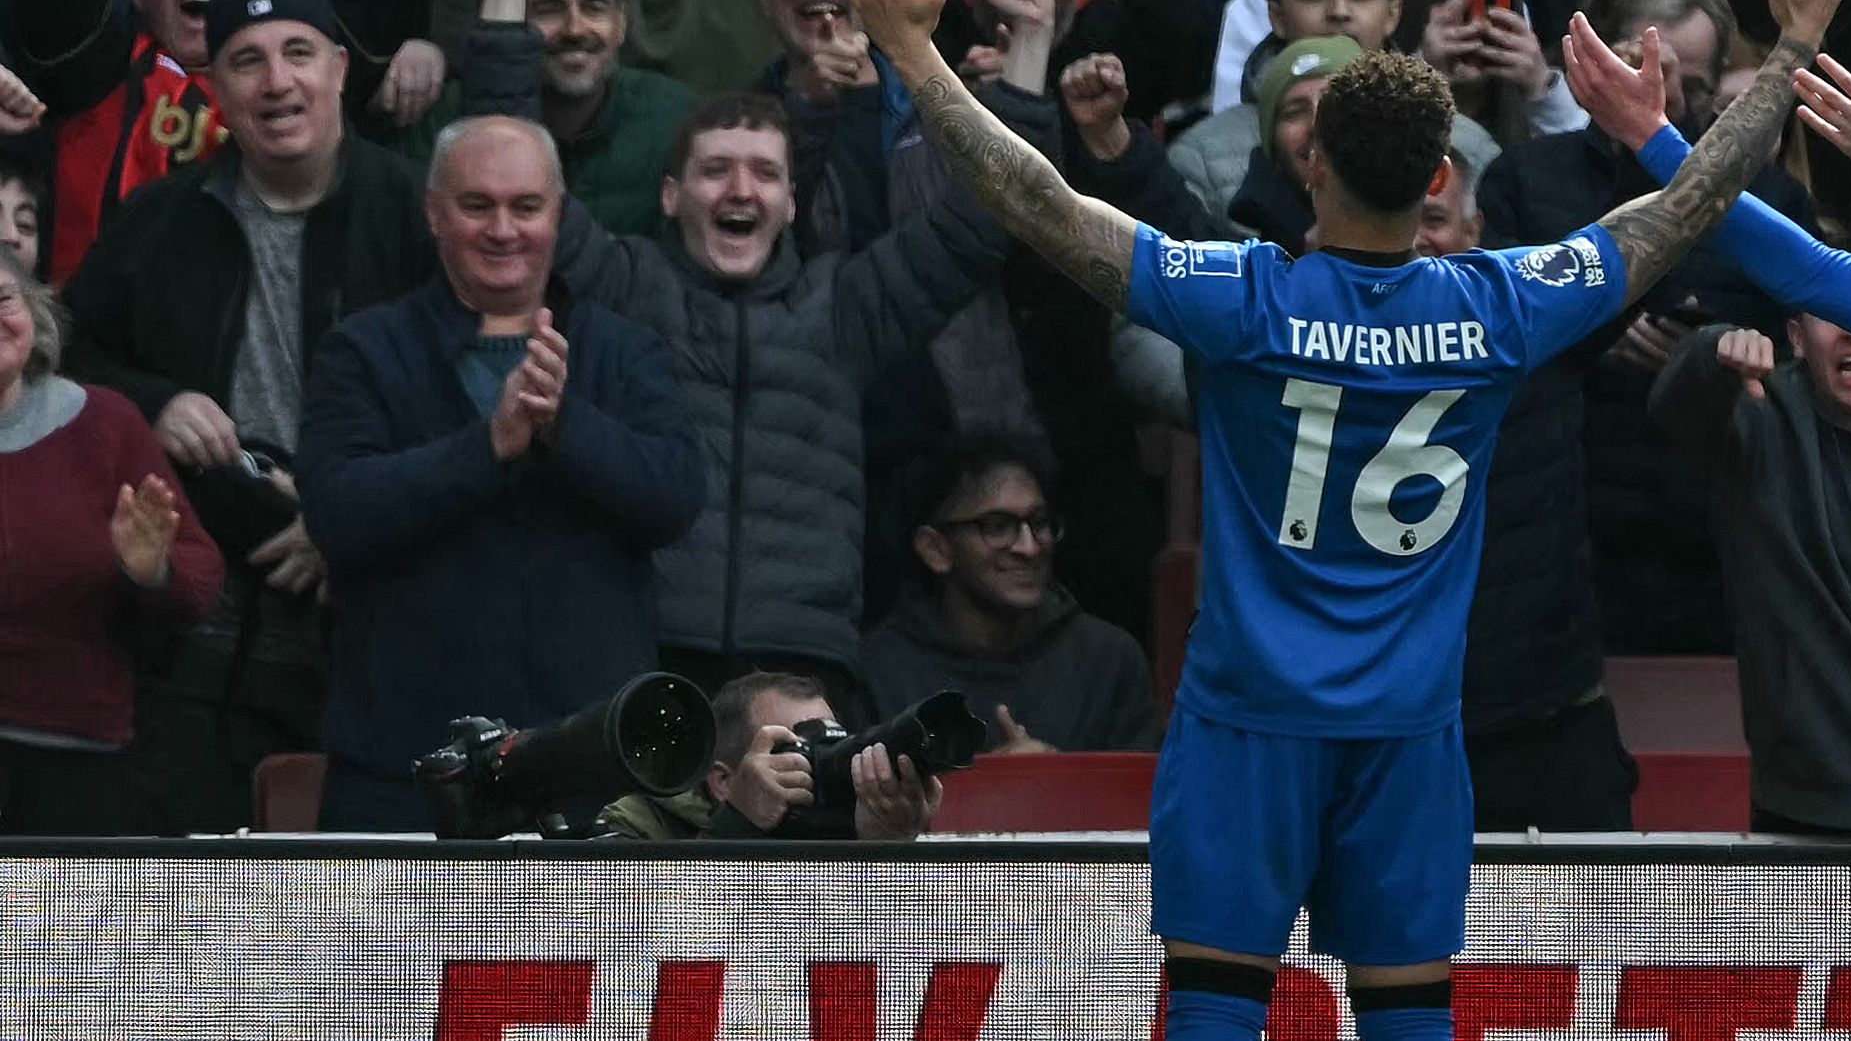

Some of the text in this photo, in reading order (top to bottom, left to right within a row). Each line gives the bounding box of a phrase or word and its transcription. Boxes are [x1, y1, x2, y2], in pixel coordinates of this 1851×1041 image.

[150, 94, 230, 164] bj
[1288, 316, 1490, 365] TAVERNIER
[1278, 377, 1470, 557] 16
